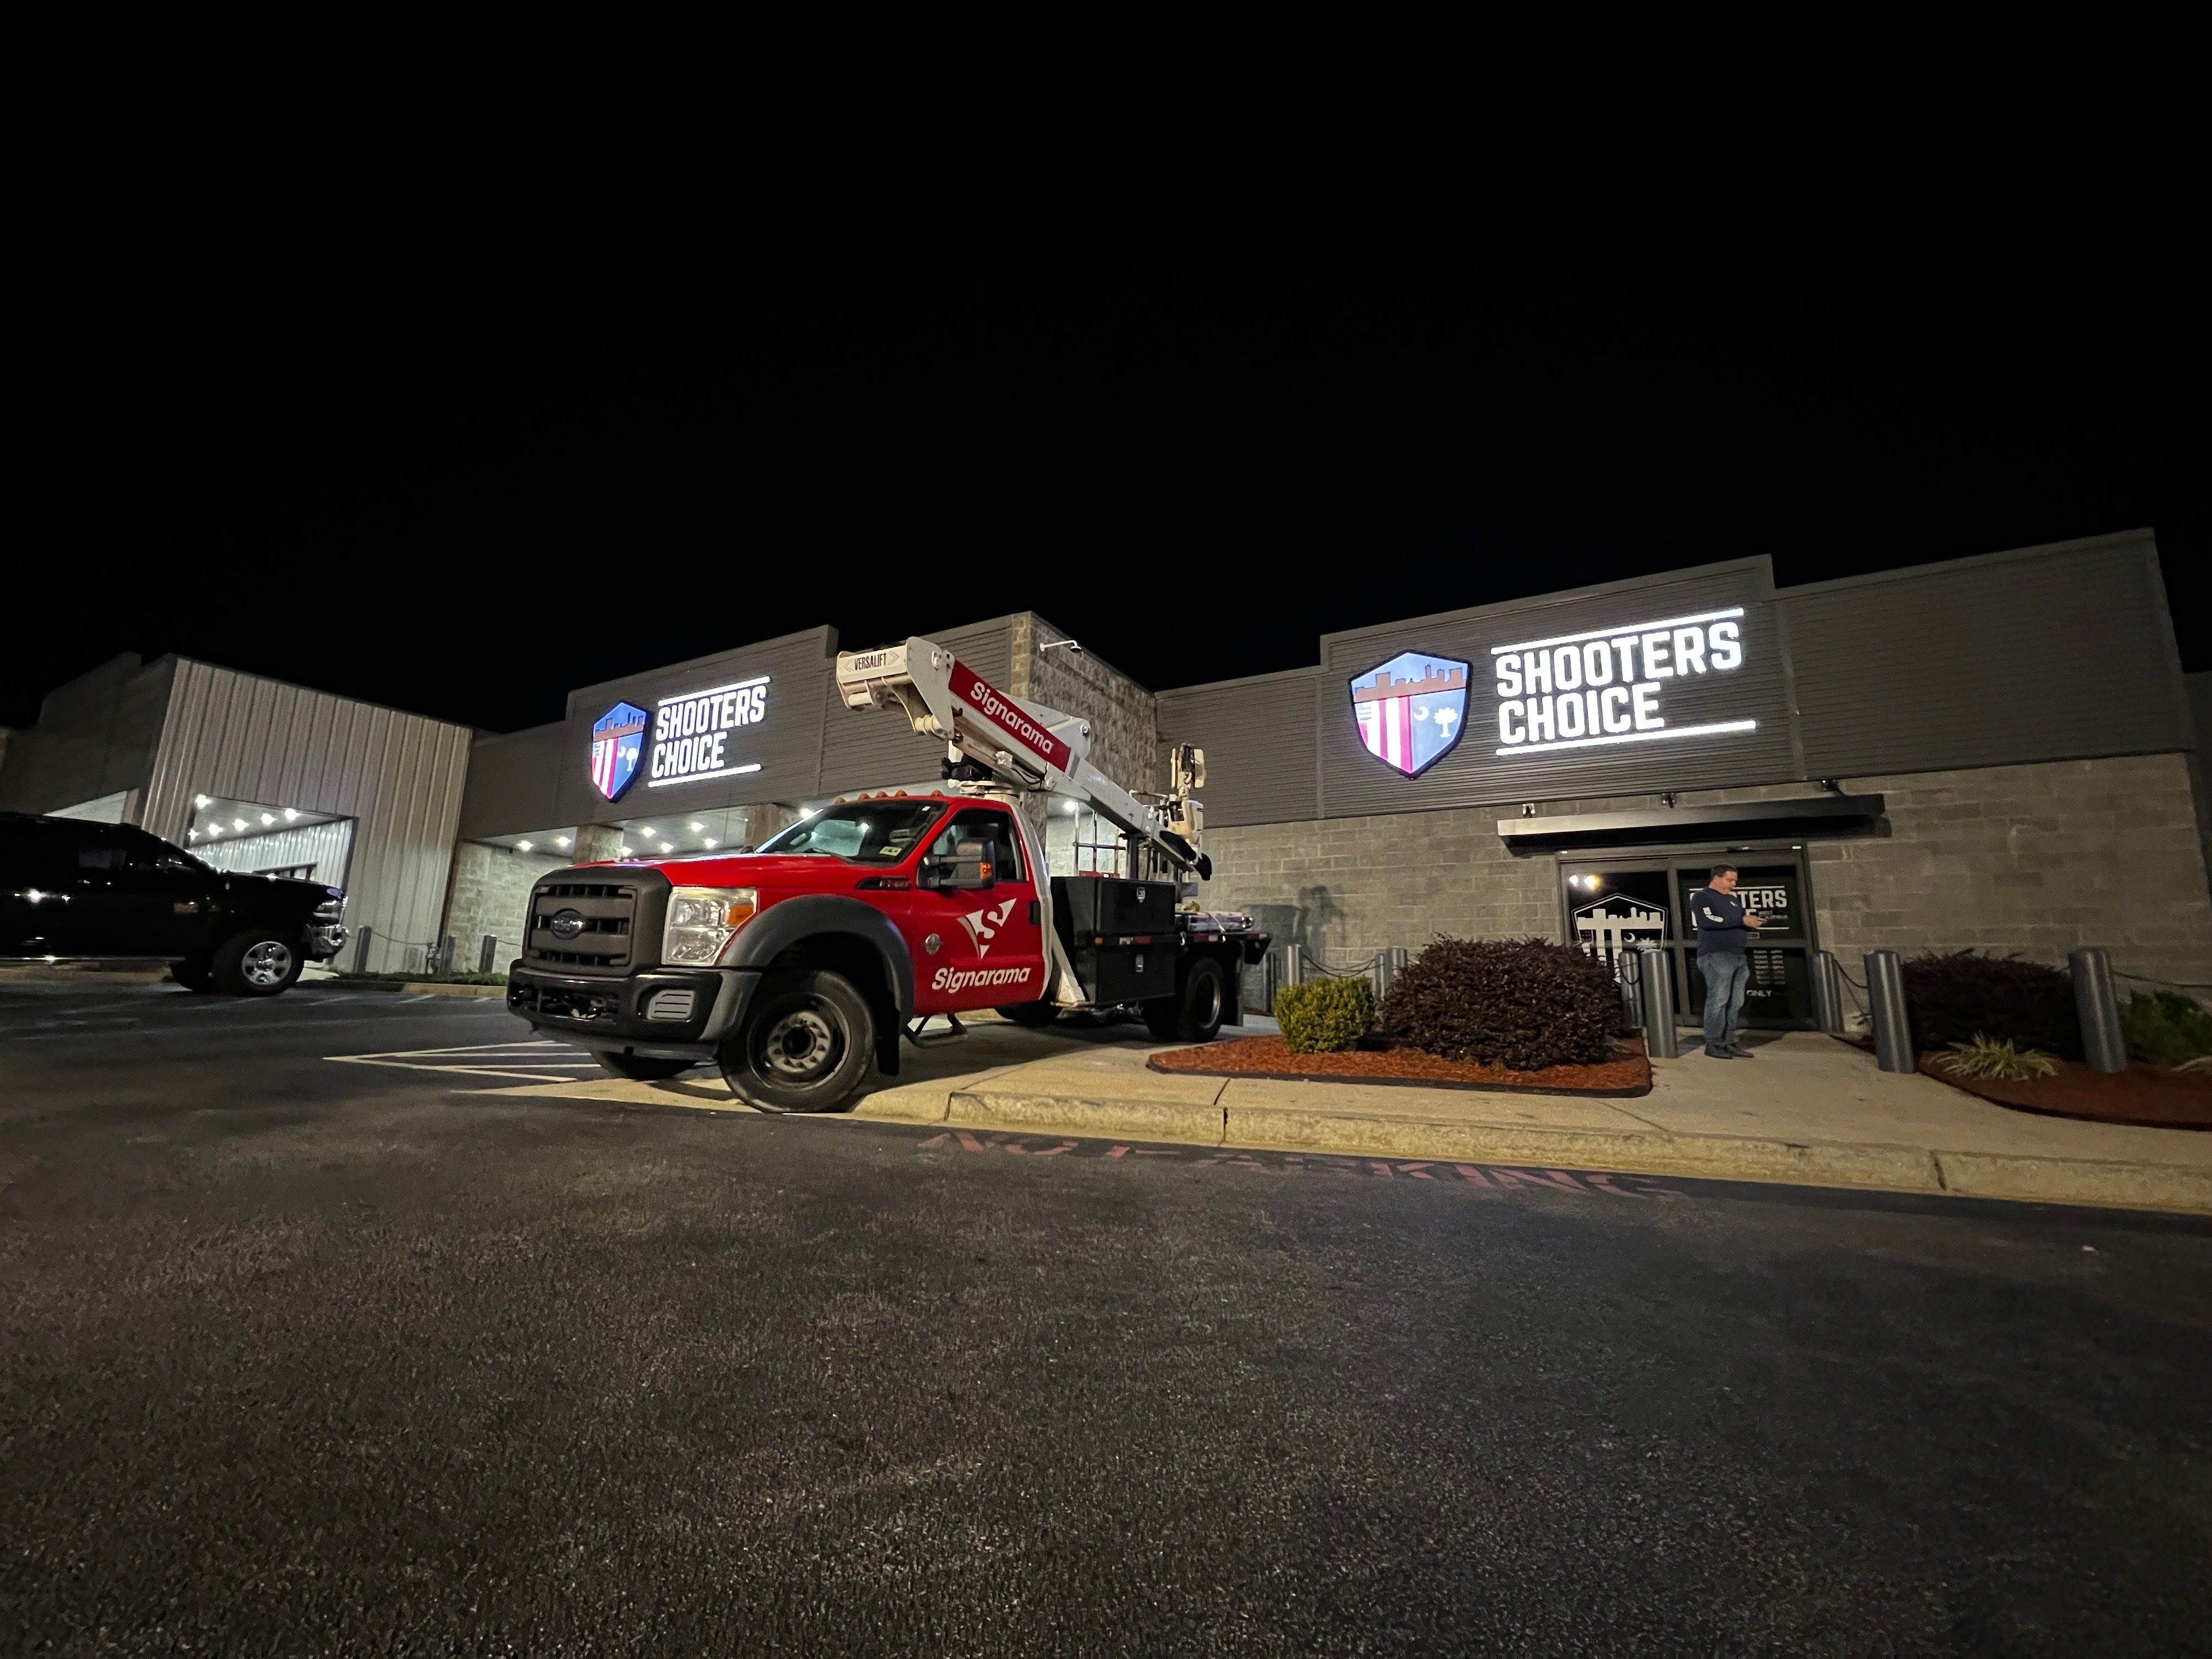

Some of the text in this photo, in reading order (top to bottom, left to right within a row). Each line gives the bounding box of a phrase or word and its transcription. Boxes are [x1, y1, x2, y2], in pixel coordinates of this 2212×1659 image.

[854, 653, 887, 670] VERSALIFT
[1496, 621, 1742, 698] SHOOTERS
[656, 685, 766, 741] SHOOTERS
[970, 682, 1054, 755] Signarama
[1497, 682, 1665, 745] CHOICE
[651, 731, 727, 778] CHOICE
[1690, 889, 1787, 909] TERS
[932, 967, 1031, 994] Signarama
